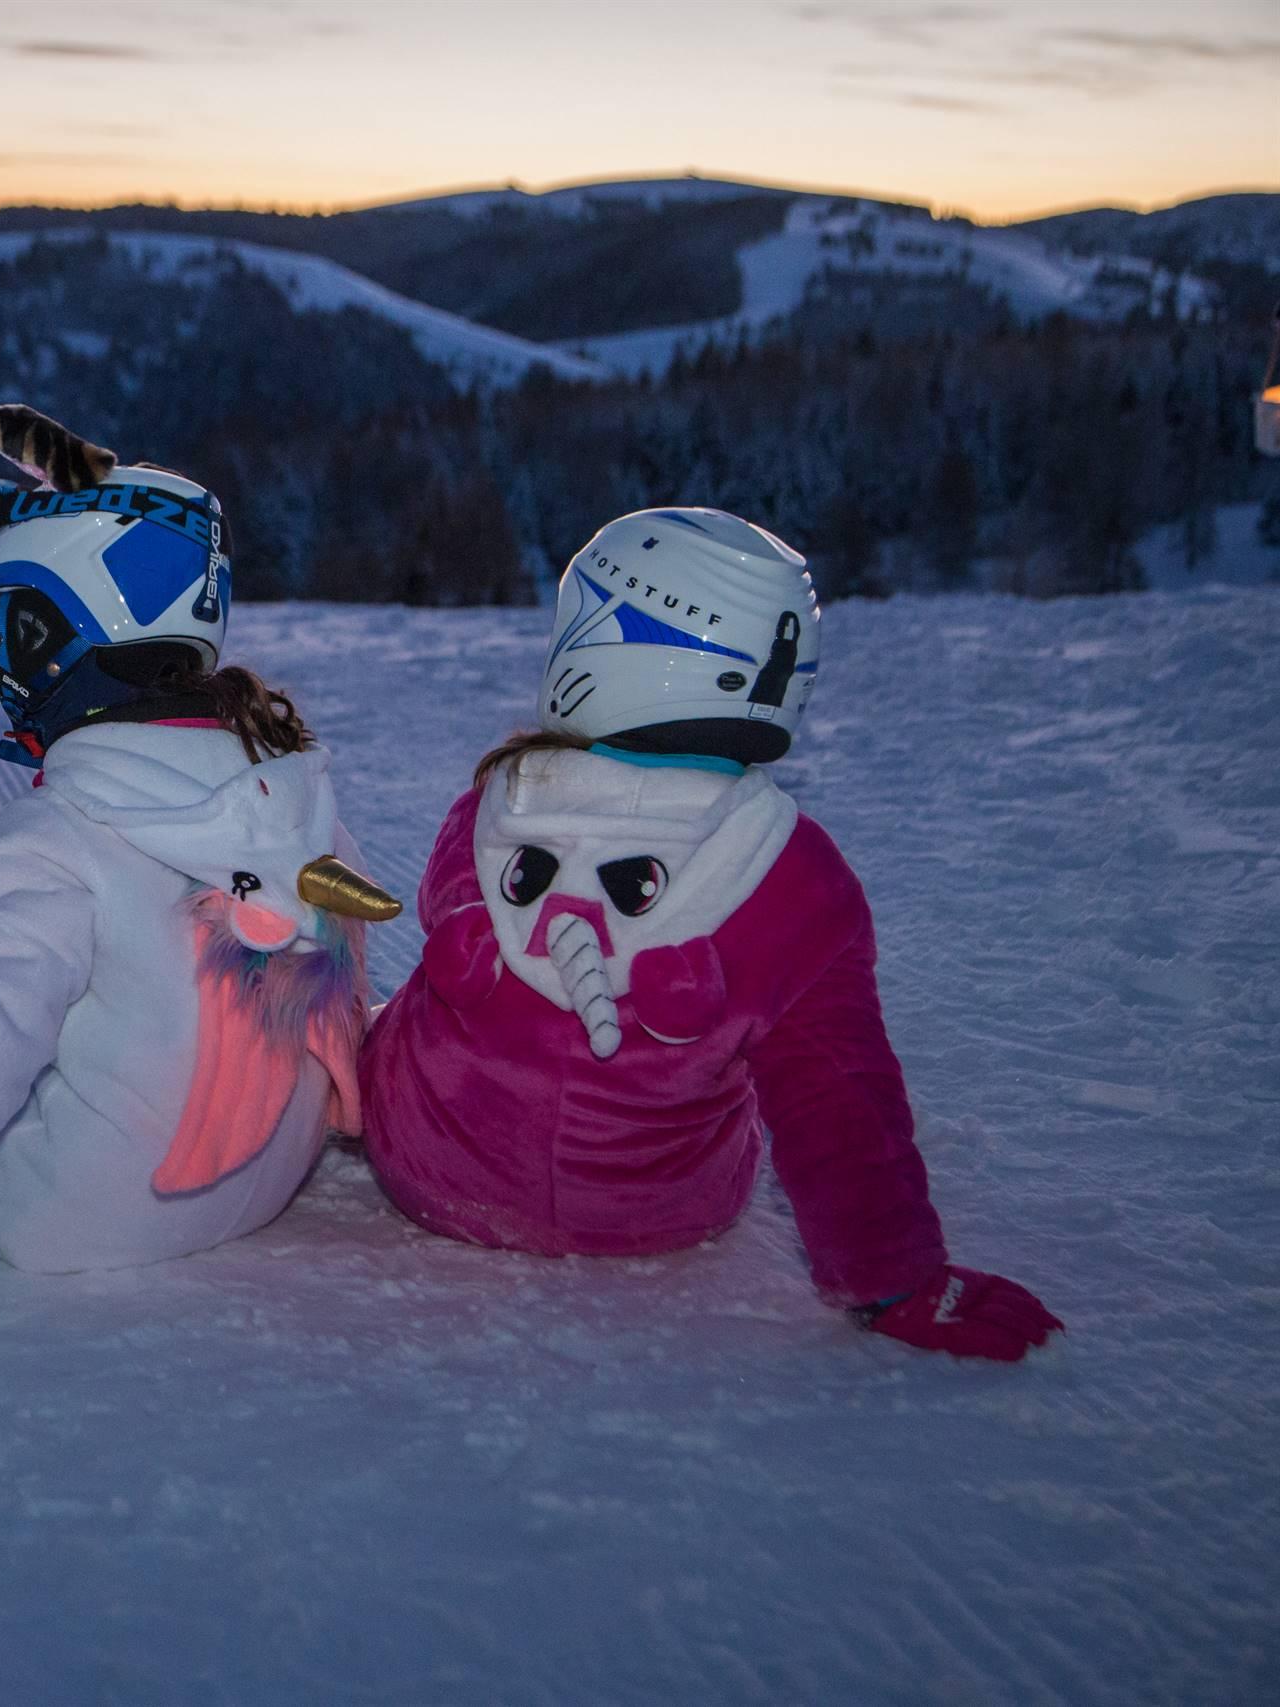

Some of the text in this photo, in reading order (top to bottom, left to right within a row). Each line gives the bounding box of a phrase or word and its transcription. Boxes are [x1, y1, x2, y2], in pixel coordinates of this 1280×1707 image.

[206, 519, 222, 600] BRIKO
[588, 547, 723, 626] HOT STUFF
[1, 674, 30, 698] BRIKO
